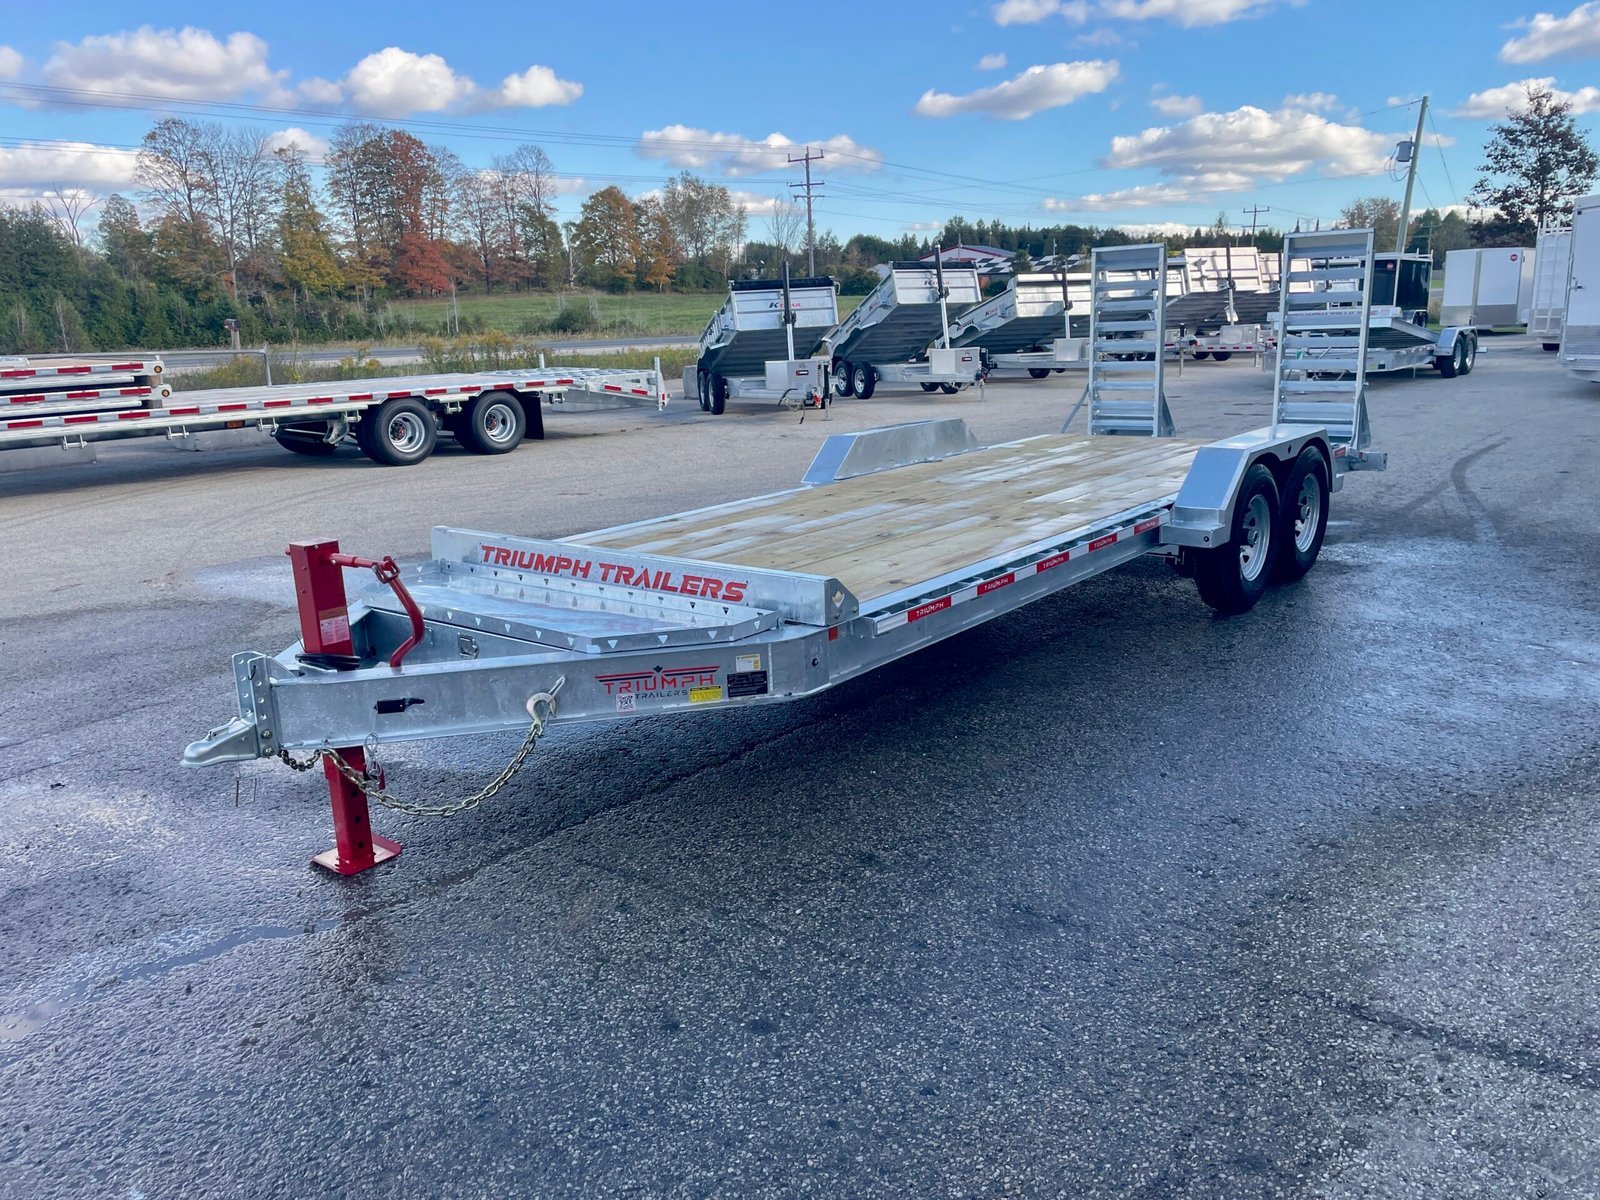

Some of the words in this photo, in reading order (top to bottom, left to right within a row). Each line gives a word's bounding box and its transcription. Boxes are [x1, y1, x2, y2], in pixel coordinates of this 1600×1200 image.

[481, 545, 592, 579] TRIUMPH
[598, 562, 748, 602] TRAILERS
[916, 602, 944, 617] TRIUMPH
[603, 674, 714, 694] TRIUMPH
[635, 689, 688, 699] TRAILERS
